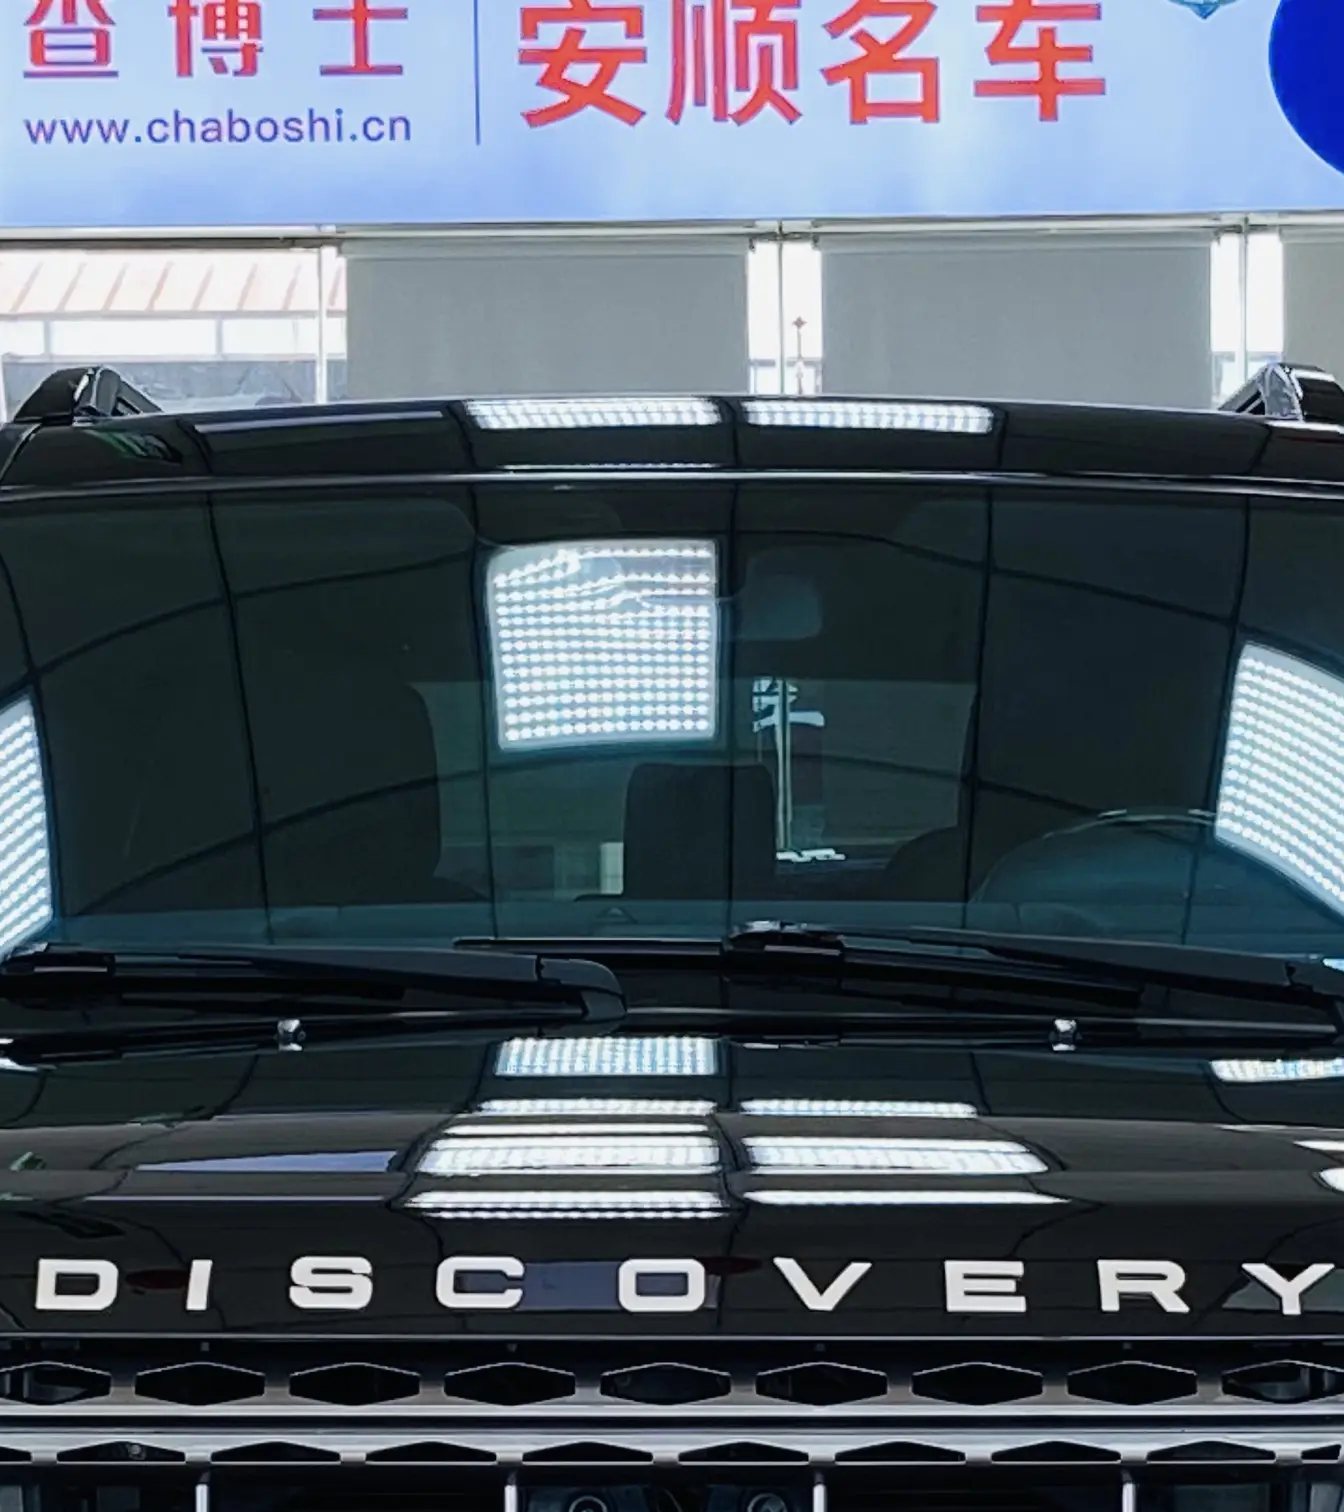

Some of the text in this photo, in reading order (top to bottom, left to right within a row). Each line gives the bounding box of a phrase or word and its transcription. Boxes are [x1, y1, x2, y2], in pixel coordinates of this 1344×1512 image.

[23, 0, 409, 78] 查博士
[518, 0, 1107, 127] 安顺名车
[24, 108, 411, 147] www.chaboshi.cn
[35, 1255, 1336, 1315] DISCOVERY
